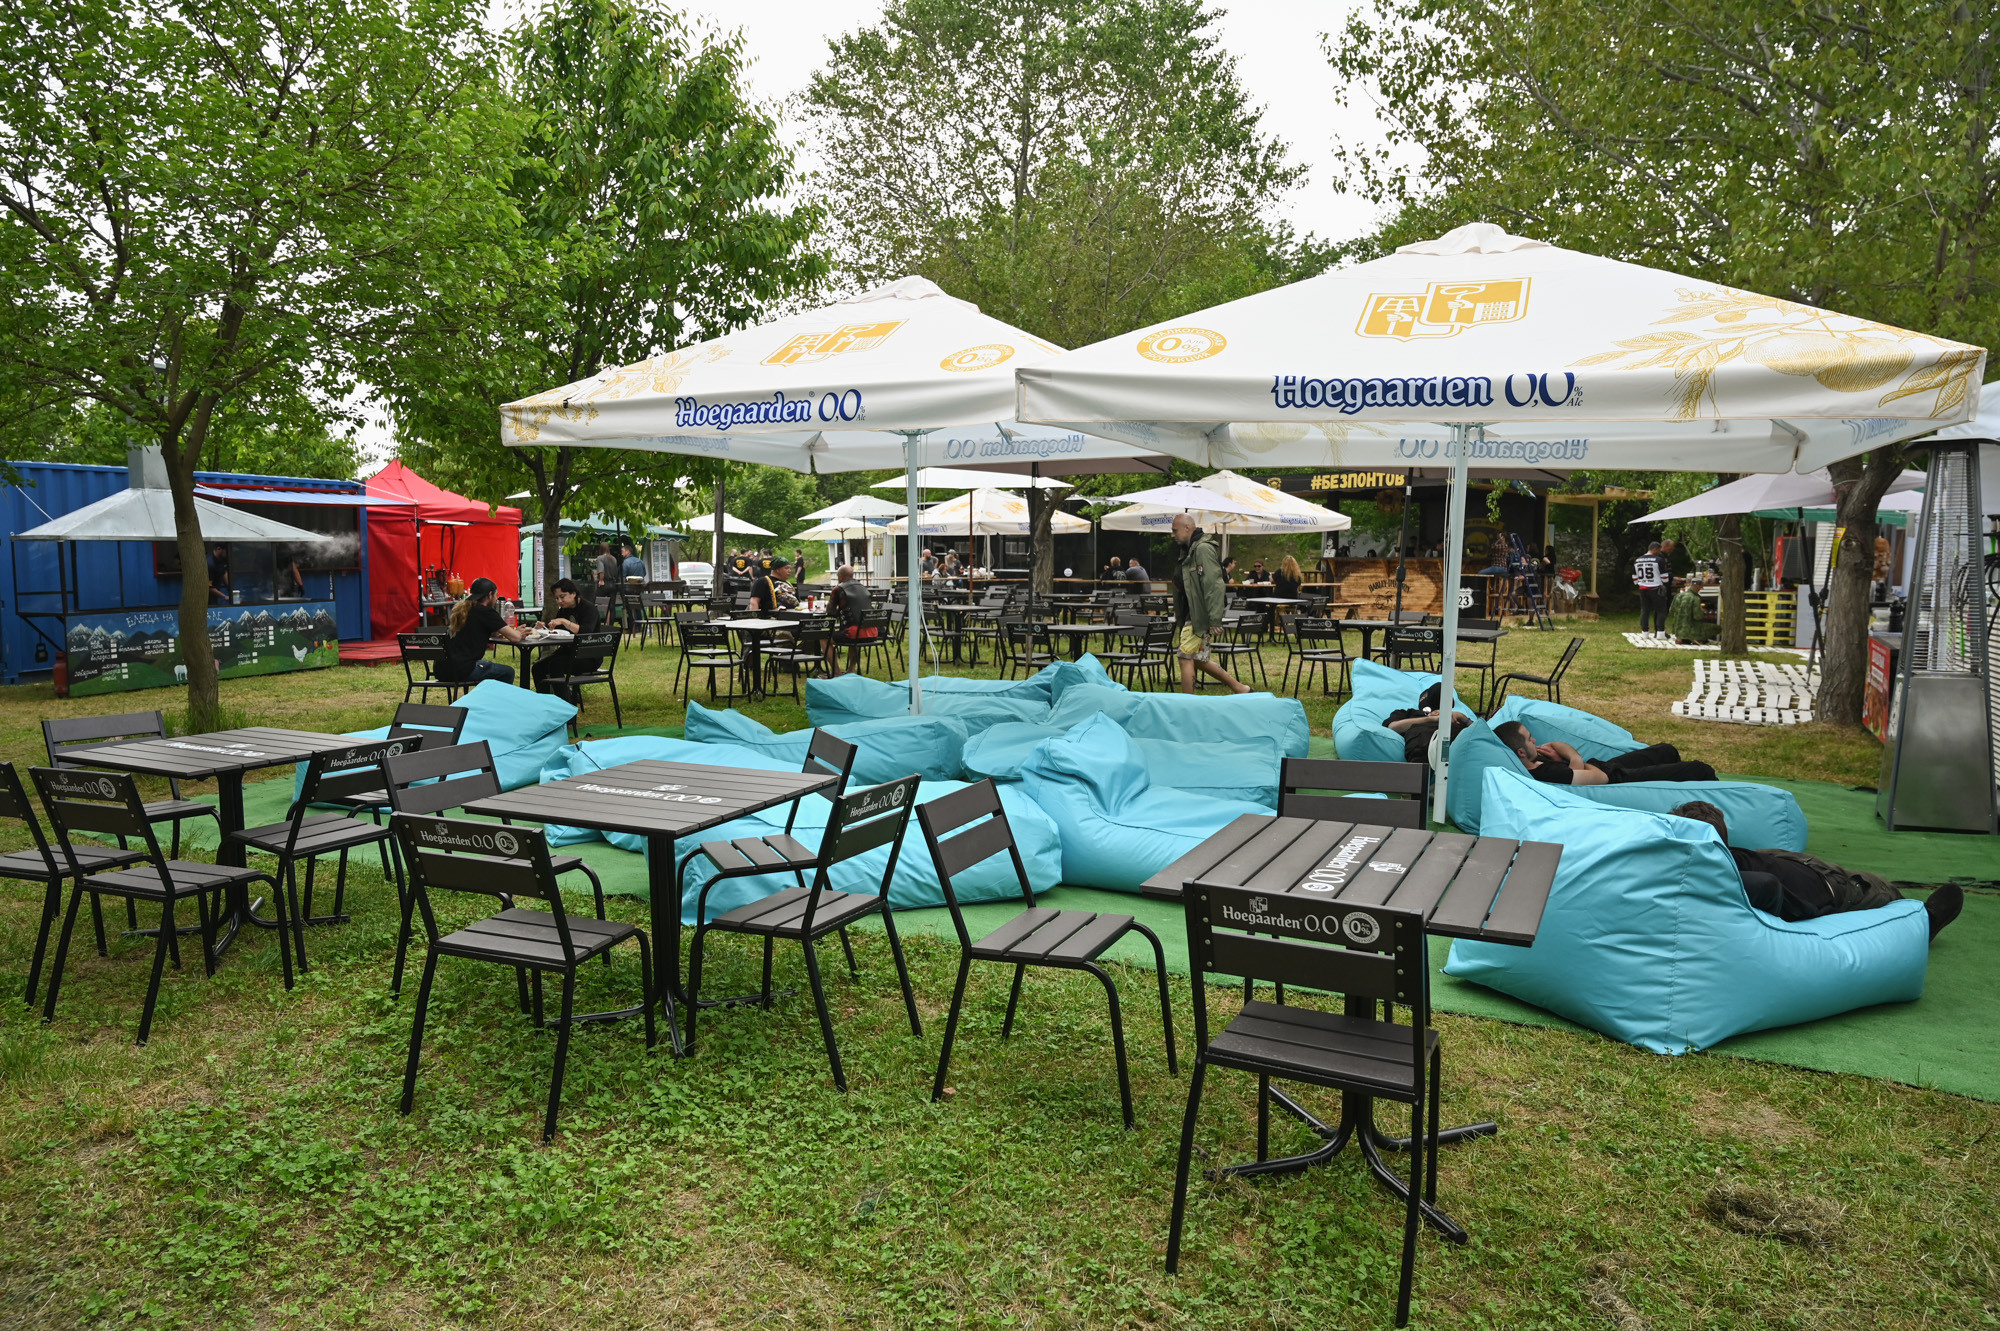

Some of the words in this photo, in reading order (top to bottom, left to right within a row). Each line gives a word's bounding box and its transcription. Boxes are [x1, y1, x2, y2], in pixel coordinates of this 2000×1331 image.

[1156, 337, 1183, 351] 0
[1271, 375, 1495, 415] Hoegaarden
[675, 391, 812, 431] Hoegaarden
[1311, 472, 1405, 490] #БЕЗПОНТОВ
[420, 830, 471, 847] Hoegaarden
[1223, 905, 1301, 930] Hoegaarden
